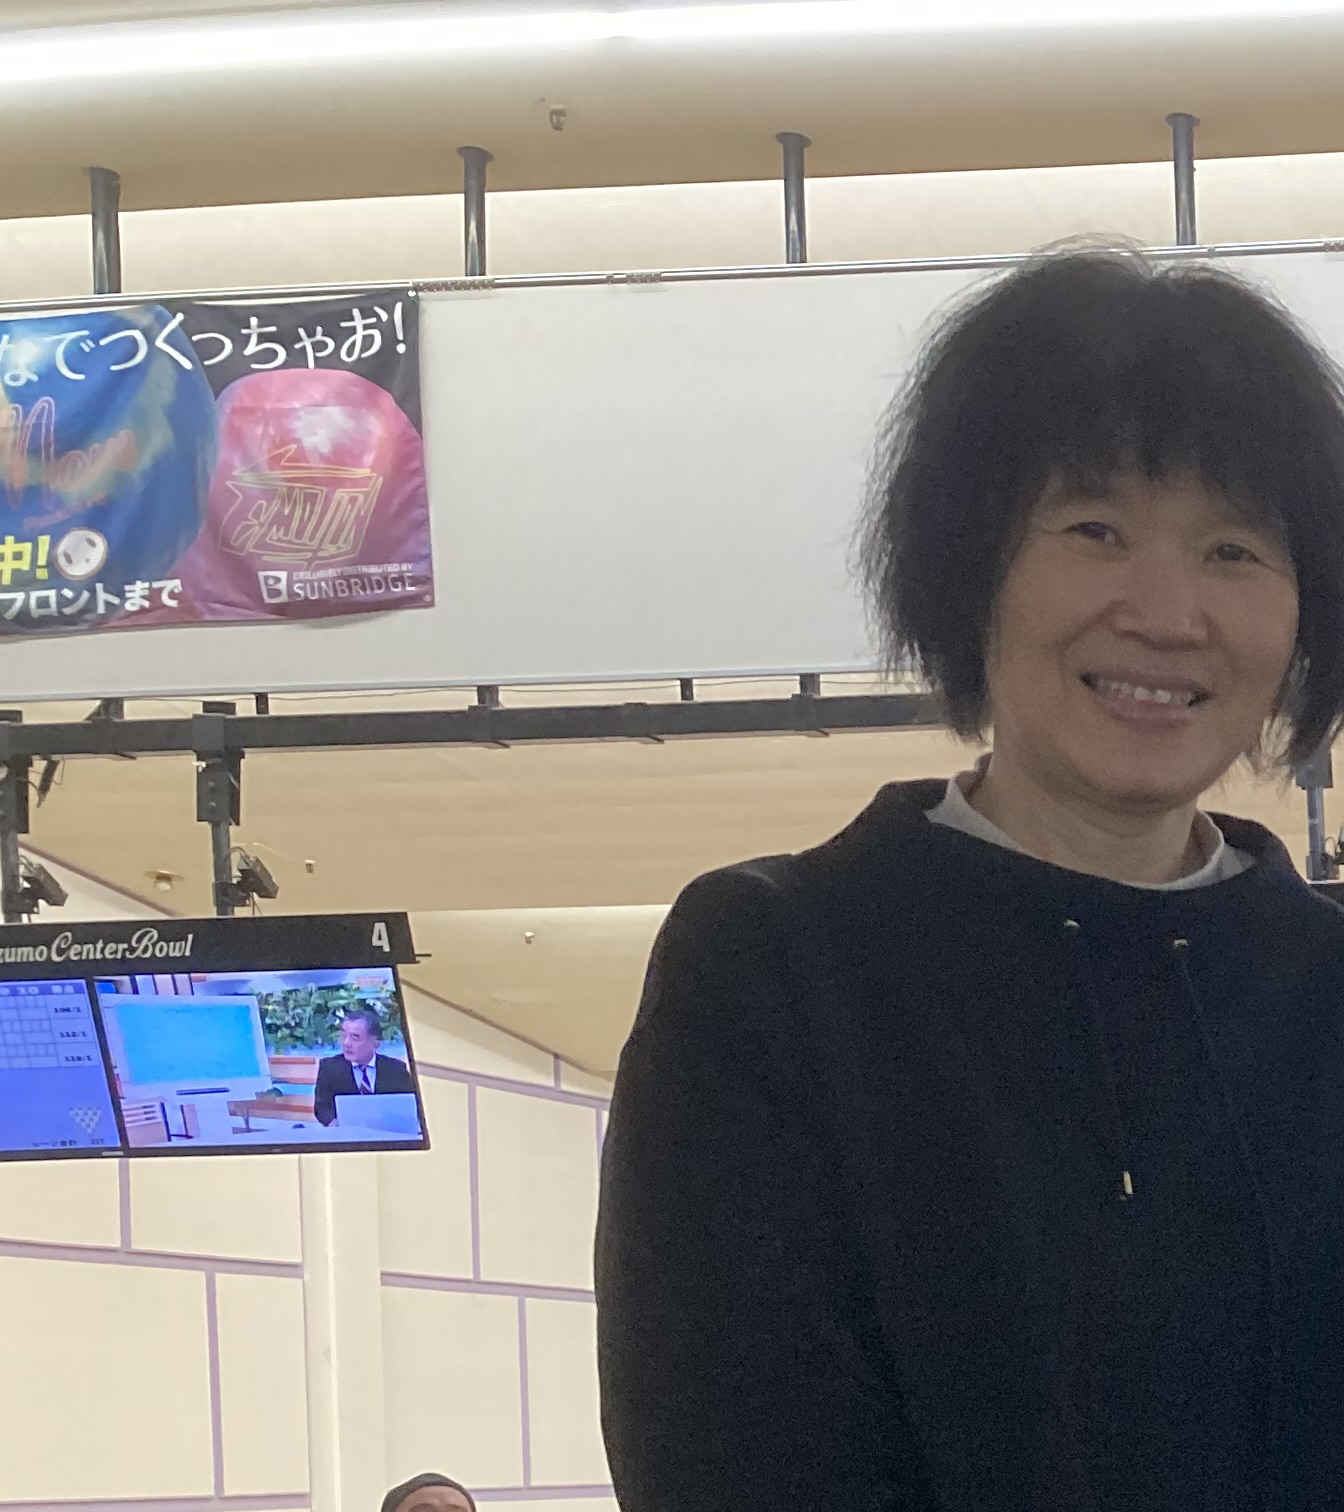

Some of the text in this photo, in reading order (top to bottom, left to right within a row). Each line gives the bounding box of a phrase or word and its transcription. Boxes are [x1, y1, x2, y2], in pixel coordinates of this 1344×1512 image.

[293, 573, 417, 601] SUNBRIDGE
[50, 931, 129, 962] Center
[126, 927, 194, 959] Bowl
[371, 921, 391, 953] 4
